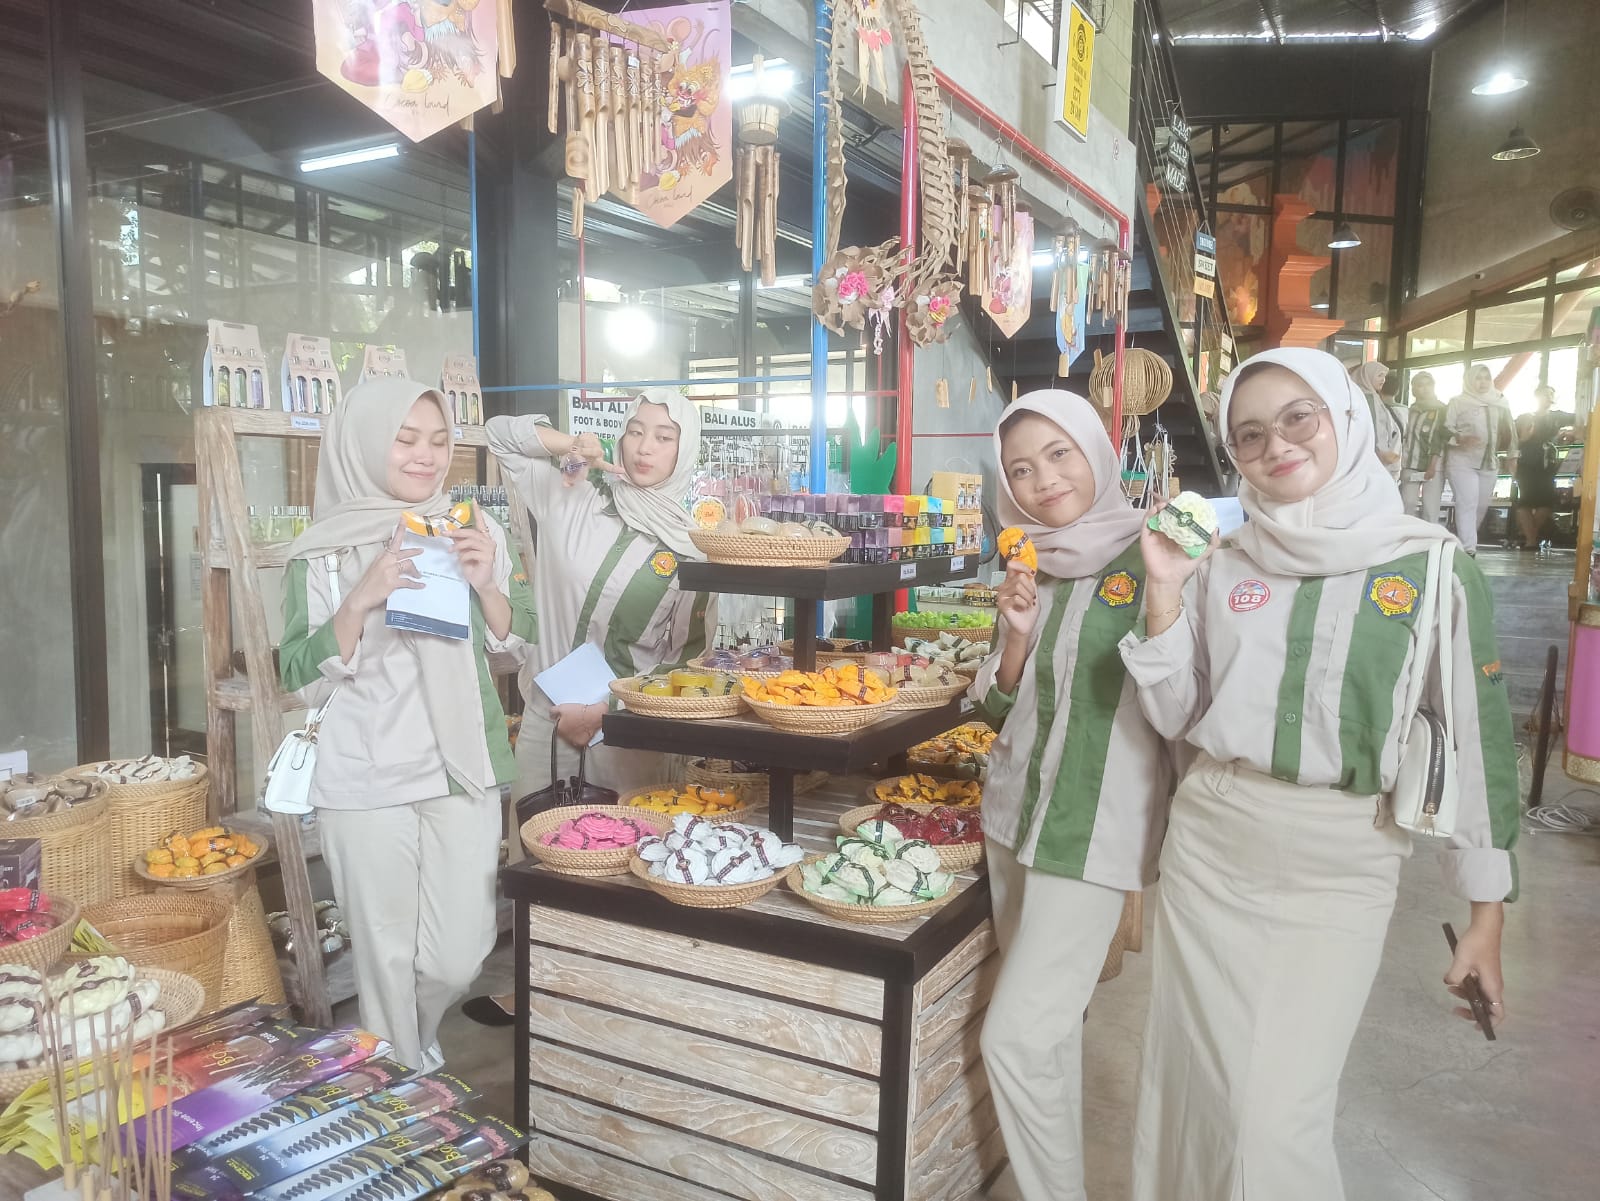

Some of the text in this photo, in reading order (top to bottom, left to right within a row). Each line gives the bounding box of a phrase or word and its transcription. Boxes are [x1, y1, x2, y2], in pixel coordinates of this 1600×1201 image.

[572, 396, 629, 414] BALI AL
[573, 416, 622, 429] FOOT & BODY
[704, 412, 756, 428] BALI ALUS
[1234, 594, 1262, 604] 108
